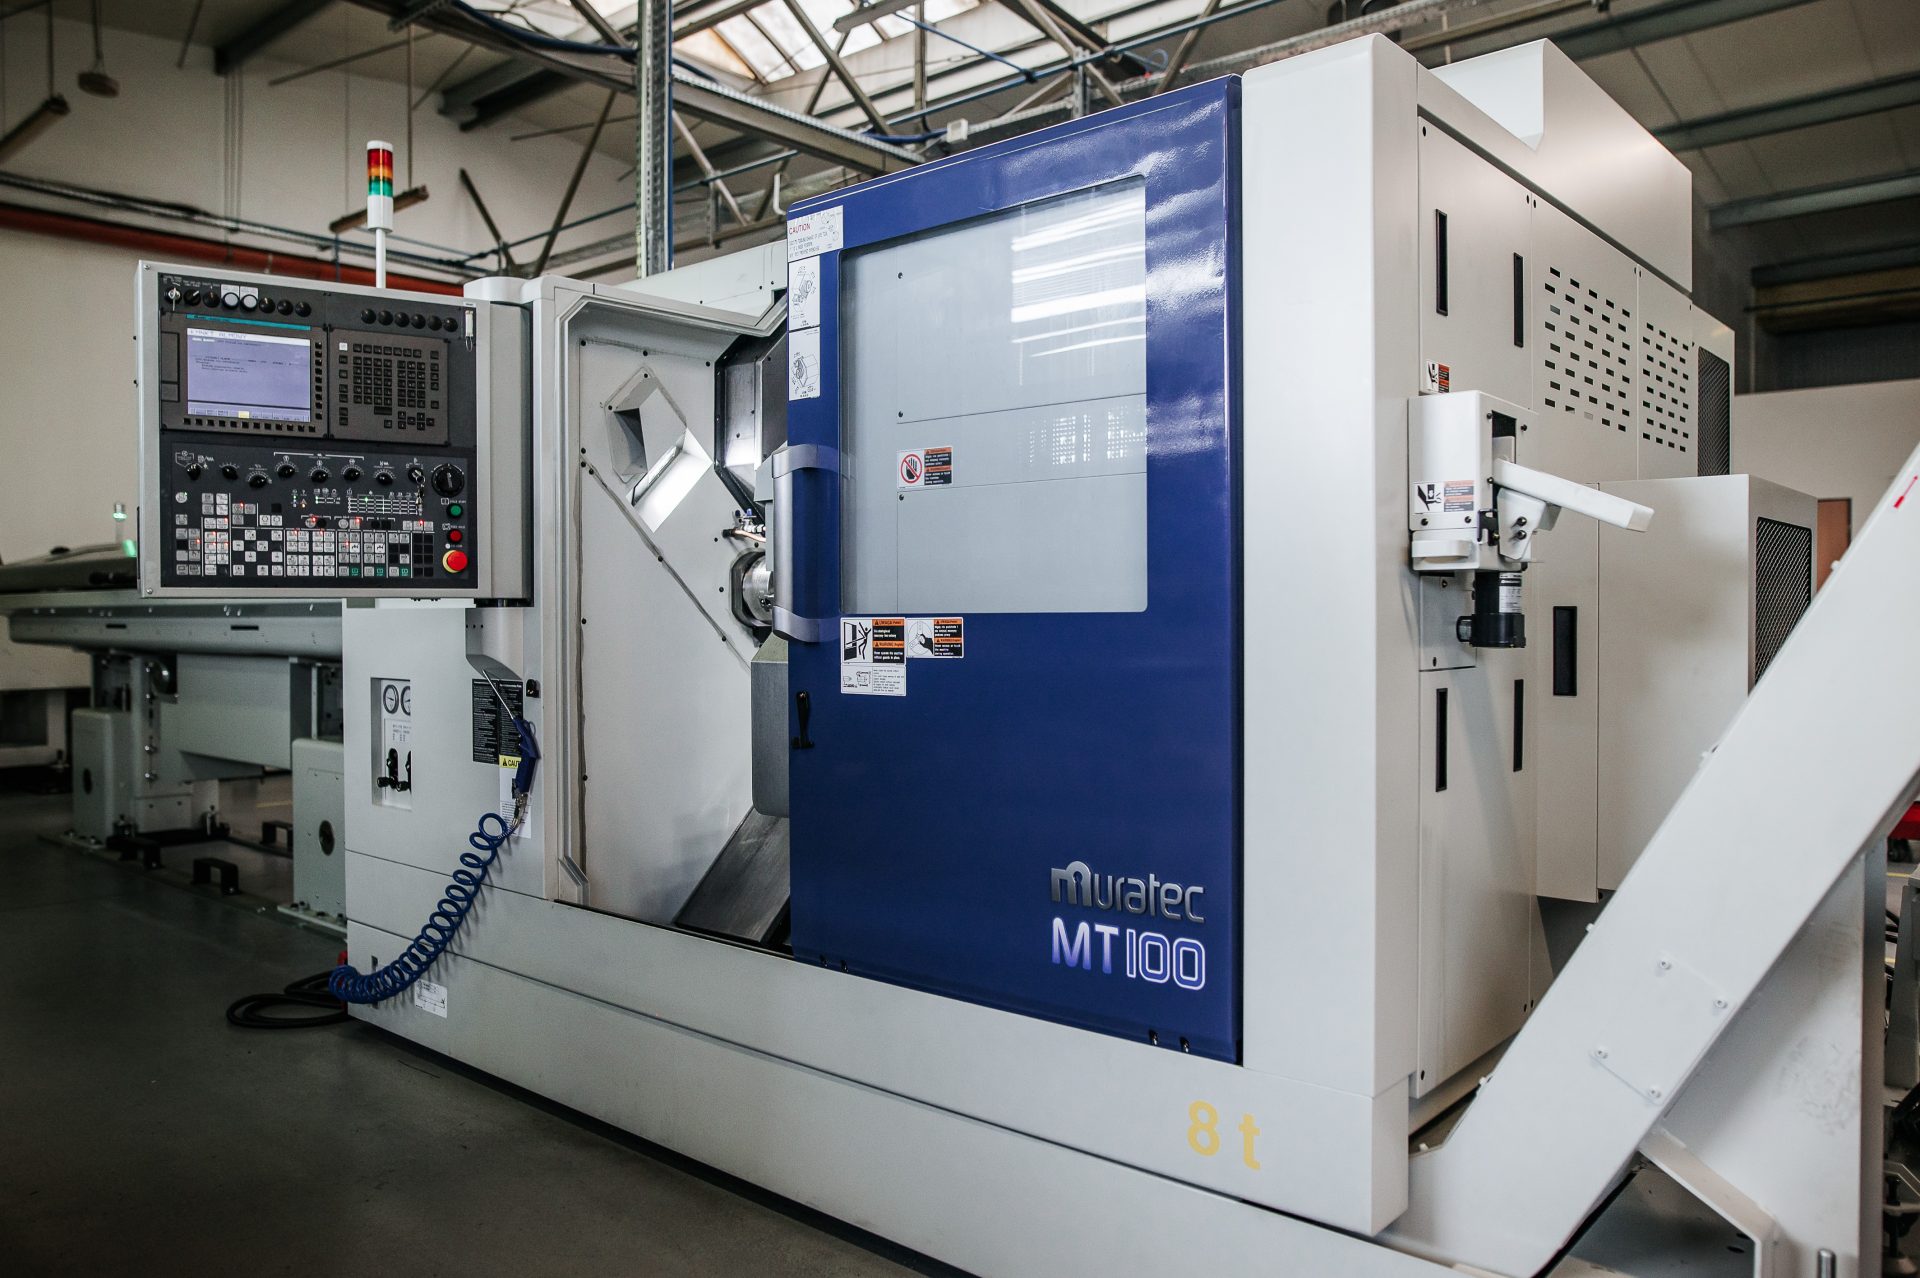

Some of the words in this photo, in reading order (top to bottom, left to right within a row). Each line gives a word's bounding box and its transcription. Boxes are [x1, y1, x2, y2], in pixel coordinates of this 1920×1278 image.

[789, 223, 811, 235] CAUTION
[1052, 917, 1205, 990] MT100
[1187, 1099, 1220, 1156] 8
[1238, 1112, 1261, 1170] t
